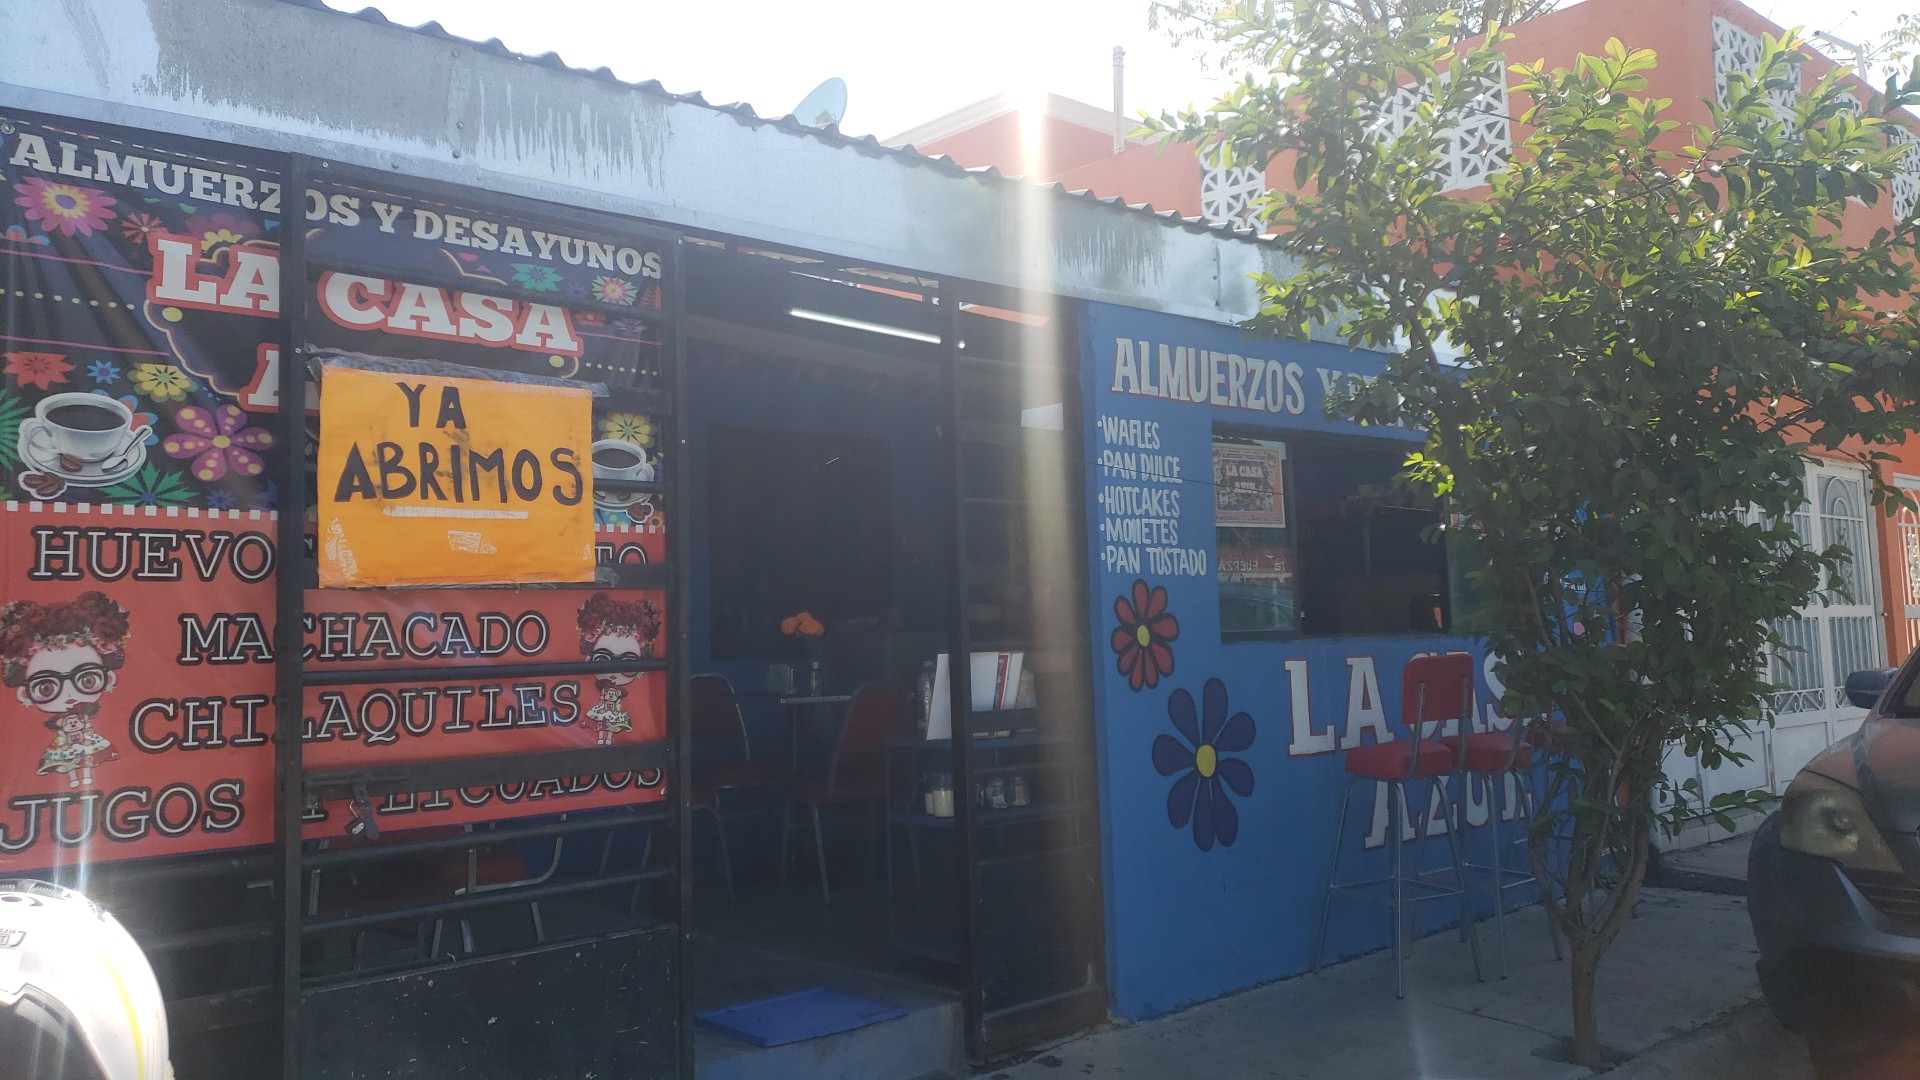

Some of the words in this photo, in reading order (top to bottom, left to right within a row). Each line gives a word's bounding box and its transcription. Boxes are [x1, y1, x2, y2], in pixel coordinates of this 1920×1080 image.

[9, 132, 360, 227] ALMUERZOS
[371, 202, 403, 234] Y
[413, 209, 662, 280] DESAYUNOS
[151, 234, 280, 316] LA
[320, 271, 581, 355] CASA
[395, 382, 467, 429] YA
[1111, 338, 1305, 415] ALMUERZOS
[1102, 415, 1160, 449] WAFLES
[334, 441, 584, 506] ABRIMOS
[1104, 450, 1137, 480] PAN
[1140, 454, 1182, 483] DULCE
[1239, 466, 1264, 478] CASA
[1105, 486, 1180, 517] HOTCAKES
[1106, 546, 1141, 574] PAN
[1146, 547, 1207, 577] TOSTADO
[132, 683, 580, 750] CHIAQUILES
[1284, 655, 1395, 757] LA
[0, 782, 242, 850] JUGOS
